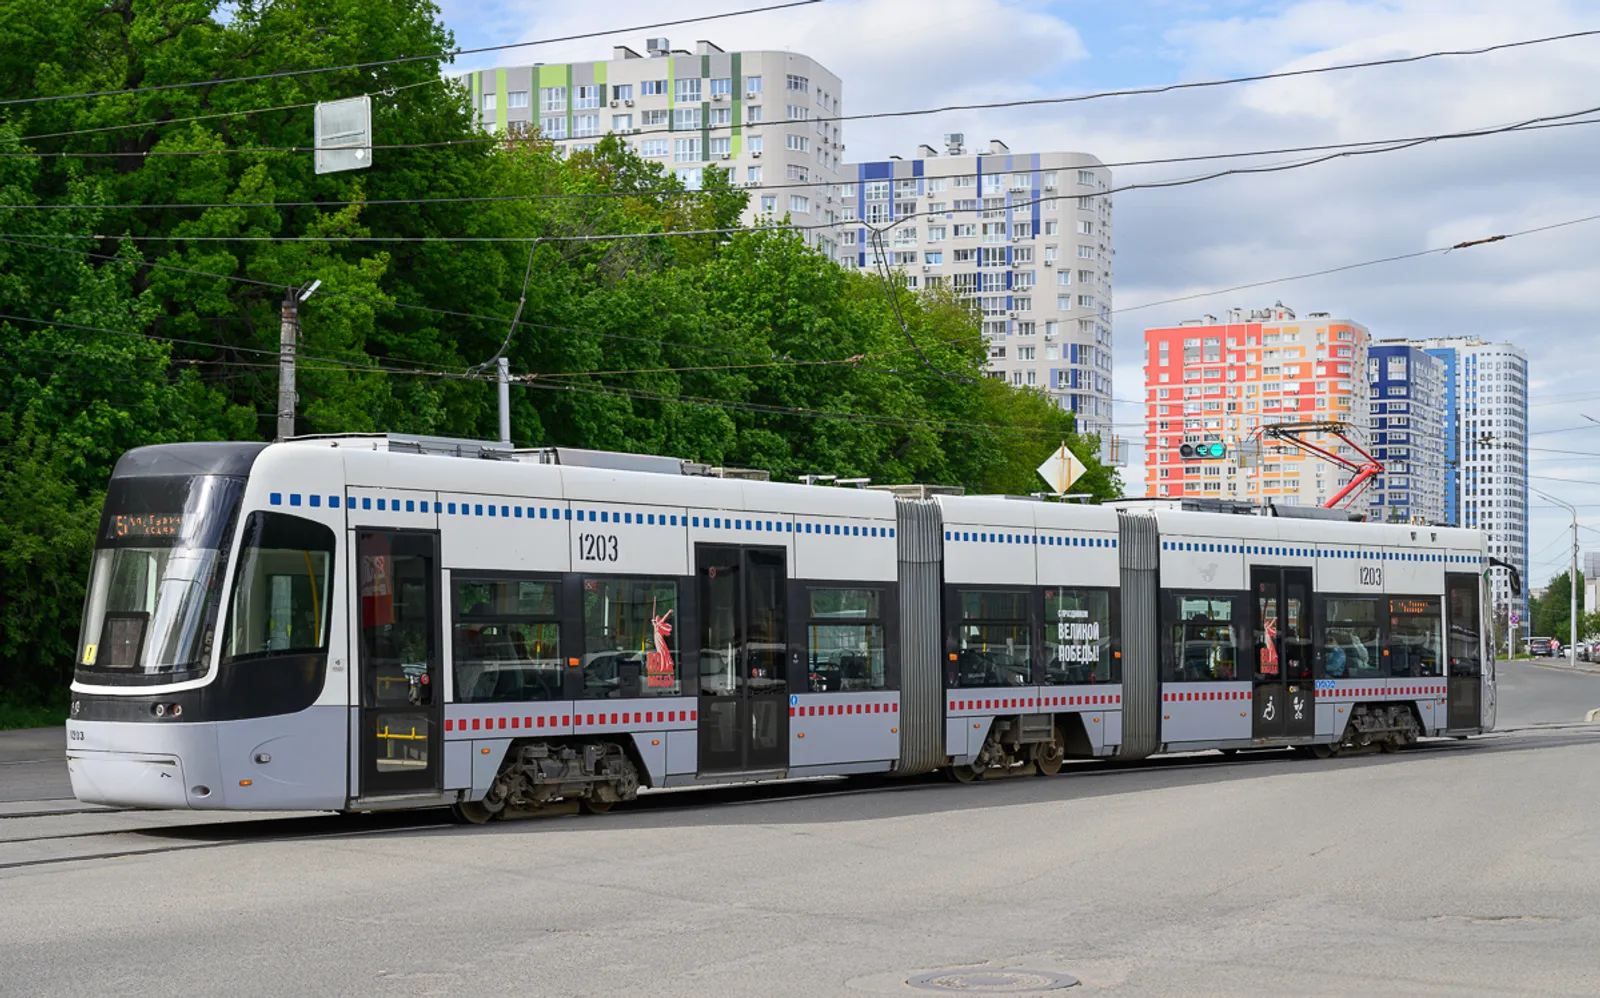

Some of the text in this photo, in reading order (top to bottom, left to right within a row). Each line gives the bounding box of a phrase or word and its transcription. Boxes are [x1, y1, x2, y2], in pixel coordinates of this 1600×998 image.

[579, 532, 618, 562] 1203
[1360, 567, 1382, 586] 1203
[1058, 621, 1100, 640] ВЕЛИКОЙ
[1058, 644, 1100, 664] ПОБЕДЫ!
